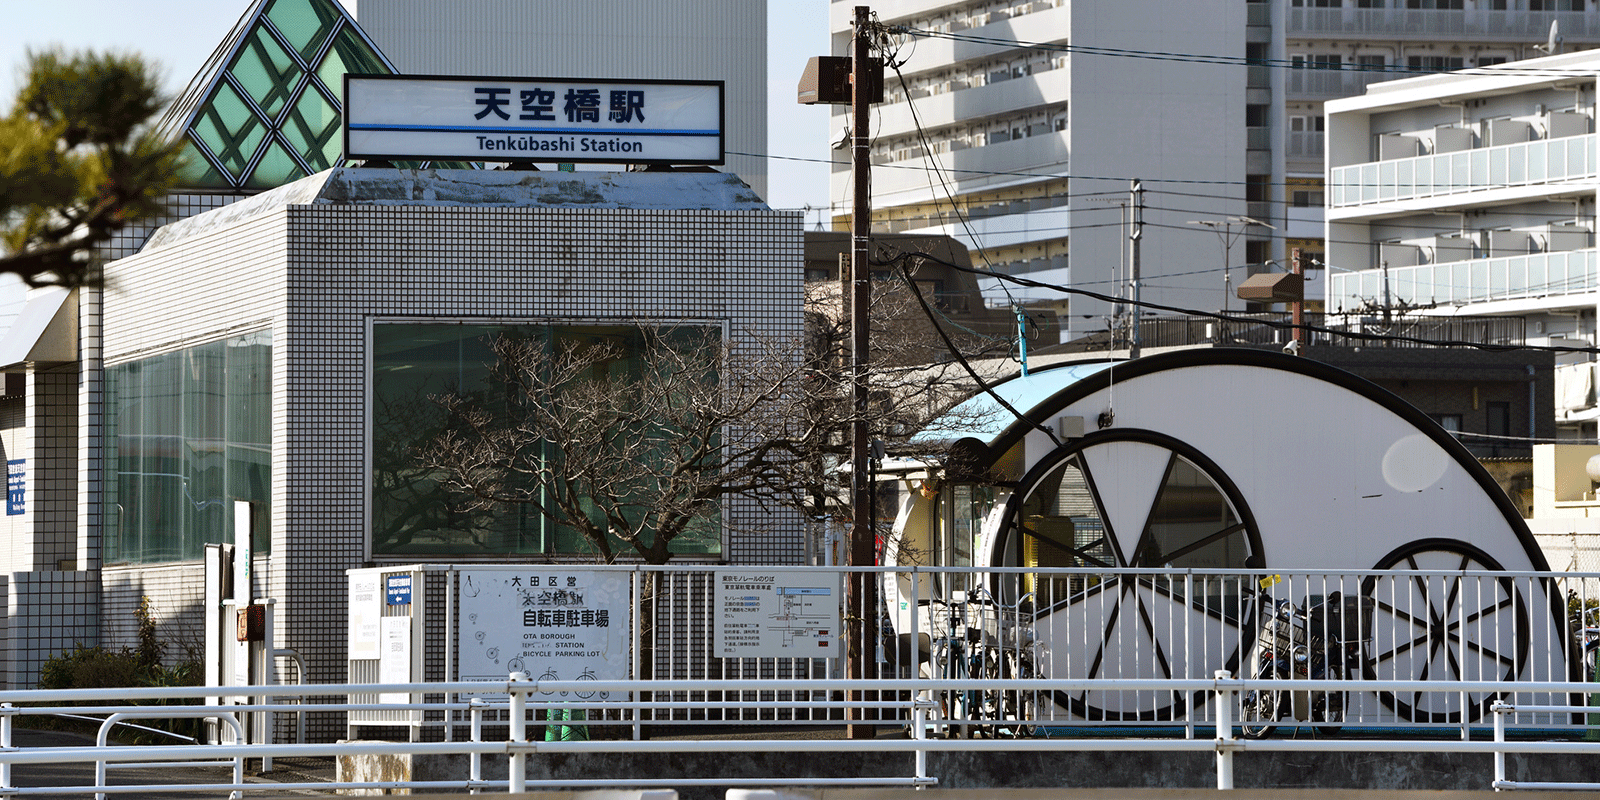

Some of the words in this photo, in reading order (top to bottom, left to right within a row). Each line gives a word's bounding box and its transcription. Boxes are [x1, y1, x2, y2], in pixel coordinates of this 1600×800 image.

[473, 87, 646, 124] 天空橋駅
[476, 135, 576, 154] Tenkūbashi
[580, 137, 643, 154] Station
[511, 576, 577, 587] 大田区営
[523, 609, 609, 628] 自転車駐車場
